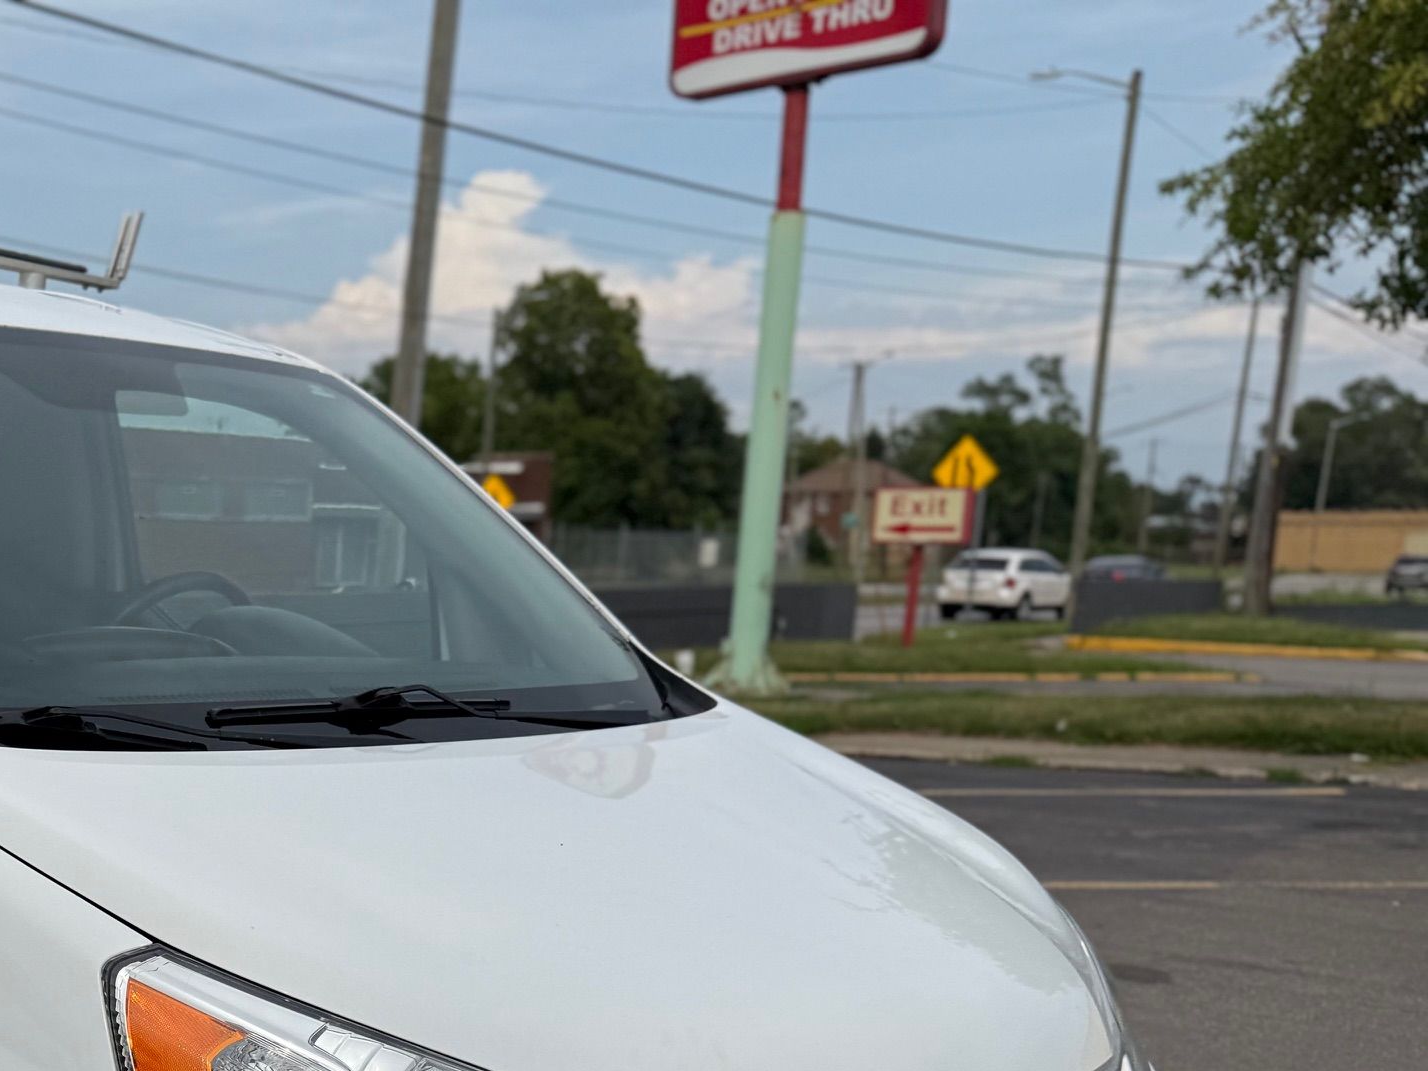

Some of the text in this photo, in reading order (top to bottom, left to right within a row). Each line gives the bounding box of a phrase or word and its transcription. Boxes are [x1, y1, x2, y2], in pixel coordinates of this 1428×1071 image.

[706, 0, 788, 20] OPE
[712, 0, 895, 54] DRIVE THRU
